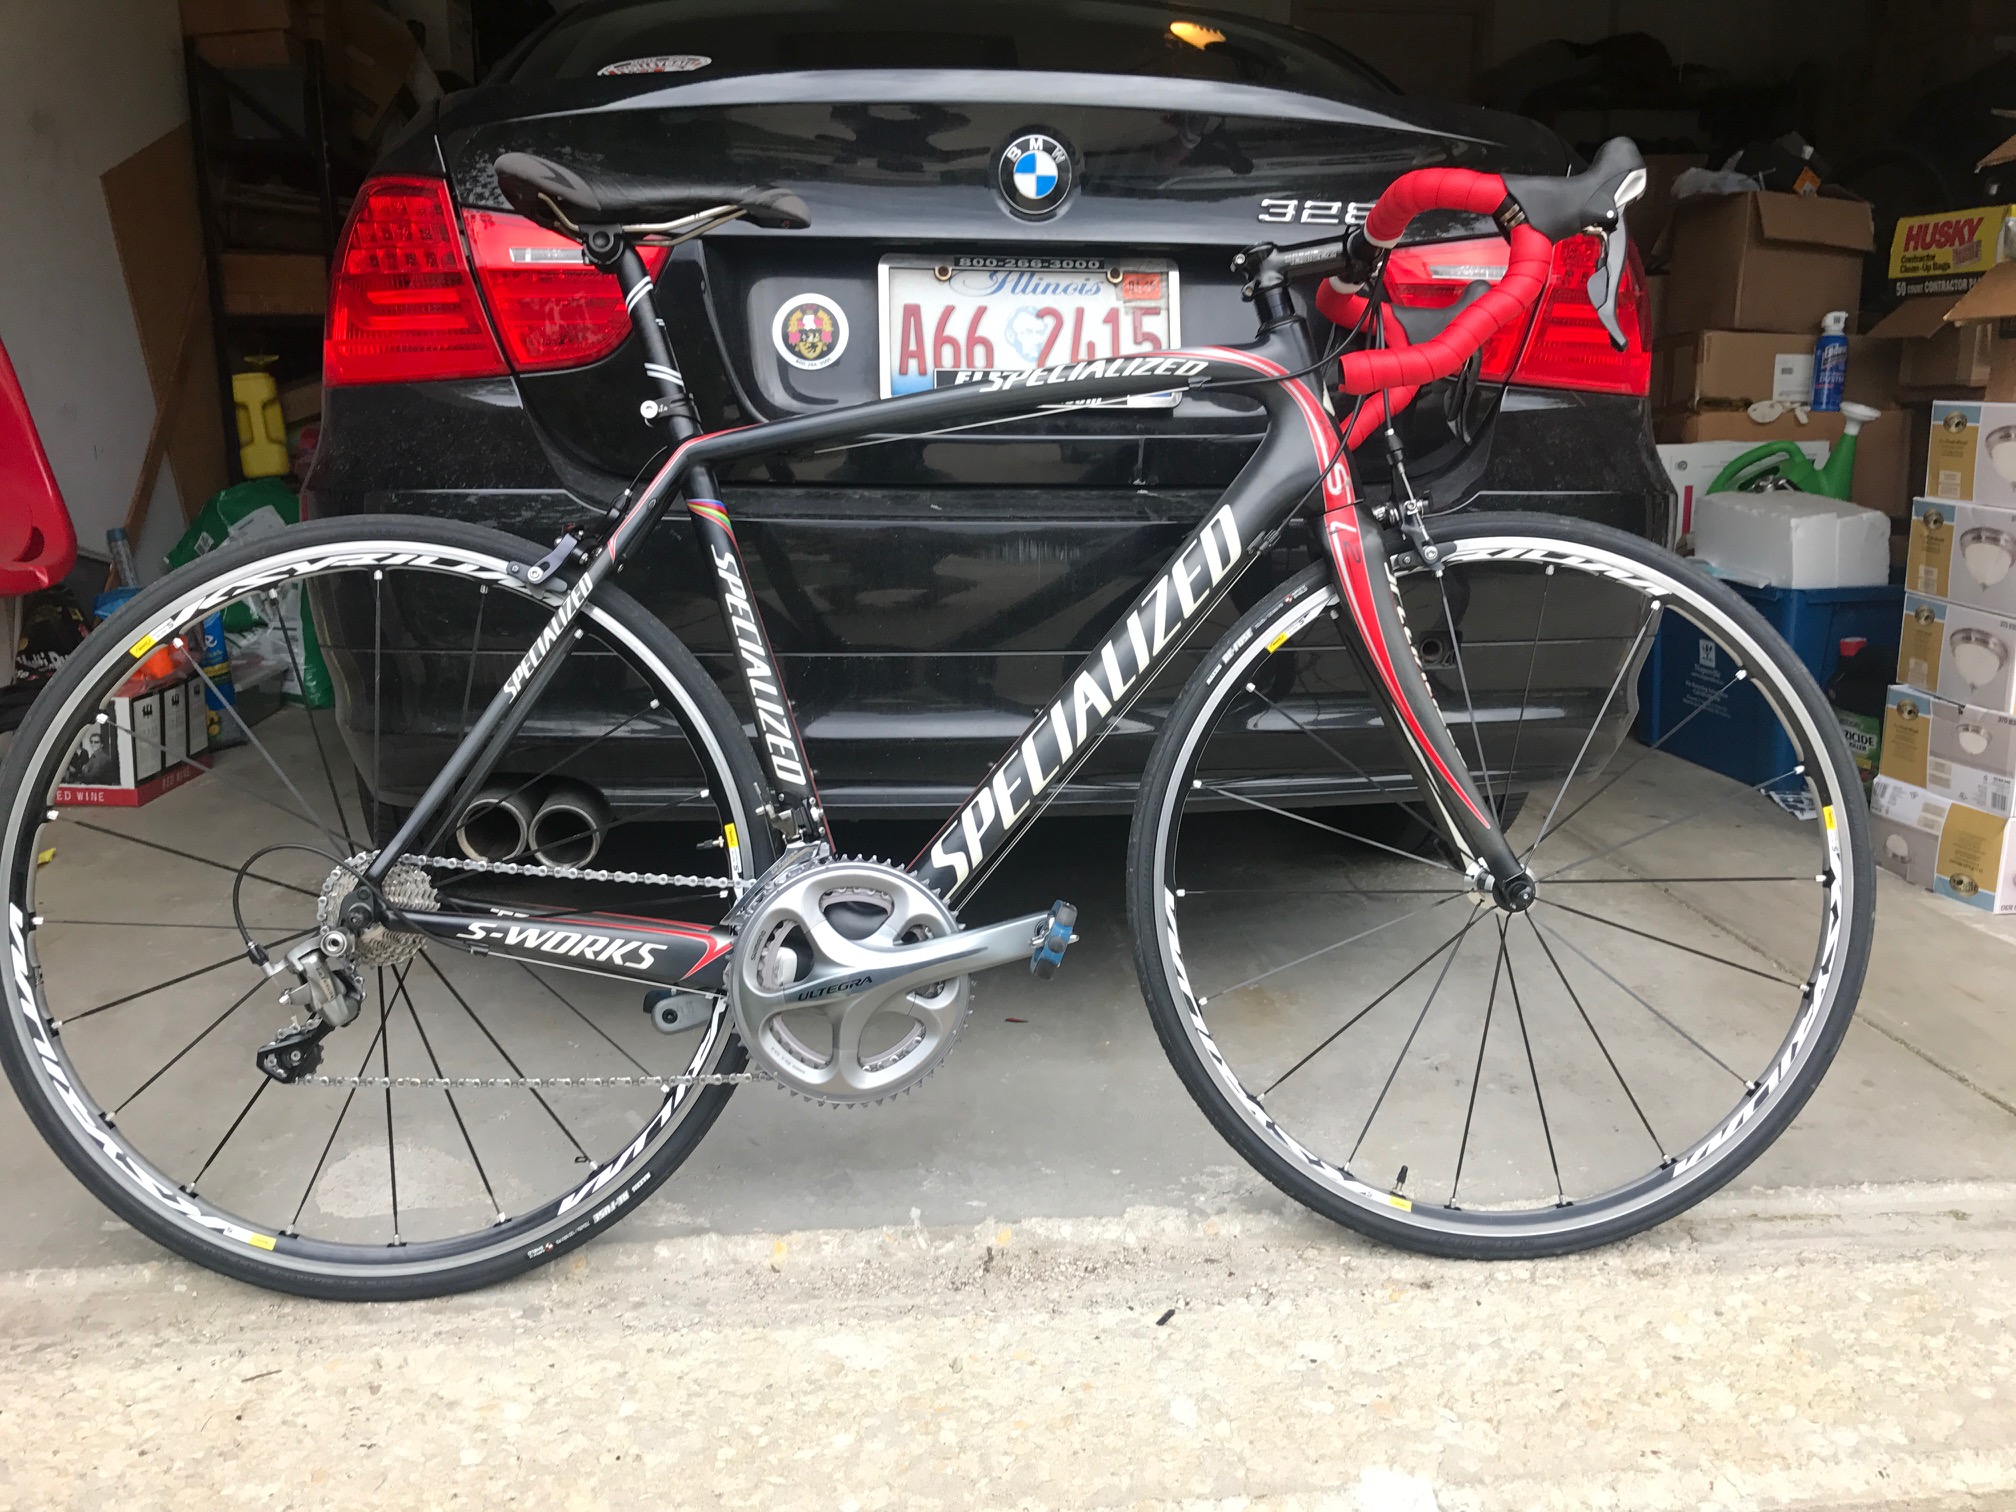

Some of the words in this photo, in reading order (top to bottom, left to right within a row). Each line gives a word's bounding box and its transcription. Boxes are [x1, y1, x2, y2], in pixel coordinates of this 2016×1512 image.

[1006, 137, 1067, 165] BMW
[1903, 217, 1984, 253] HUSKY
[958, 257, 1101, 270] 800-266-3000
[1901, 253, 1936, 263] Contractor
[948, 270, 1104, 298] Illinois
[1896, 281, 1907, 297] 50
[1924, 278, 1968, 293] CONTRACTOR
[898, 302, 995, 376] A66
[1036, 306, 1163, 368] 2415
[979, 357, 1210, 393] SPECIALIZED
[503, 571, 594, 705] SPECIALIZED
[1221, 627, 1255, 666] RE-FUSE
[711, 543, 807, 786] SPECIALIZED
[930, 503, 1242, 900] SPECIALIZED
[56, 789, 72, 801] ED
[76, 790, 105, 802] WINE
[456, 921, 668, 971] S-WORKS
[797, 975, 874, 1002] ULTEGRA
[592, 1188, 631, 1225] RE-FUSE
